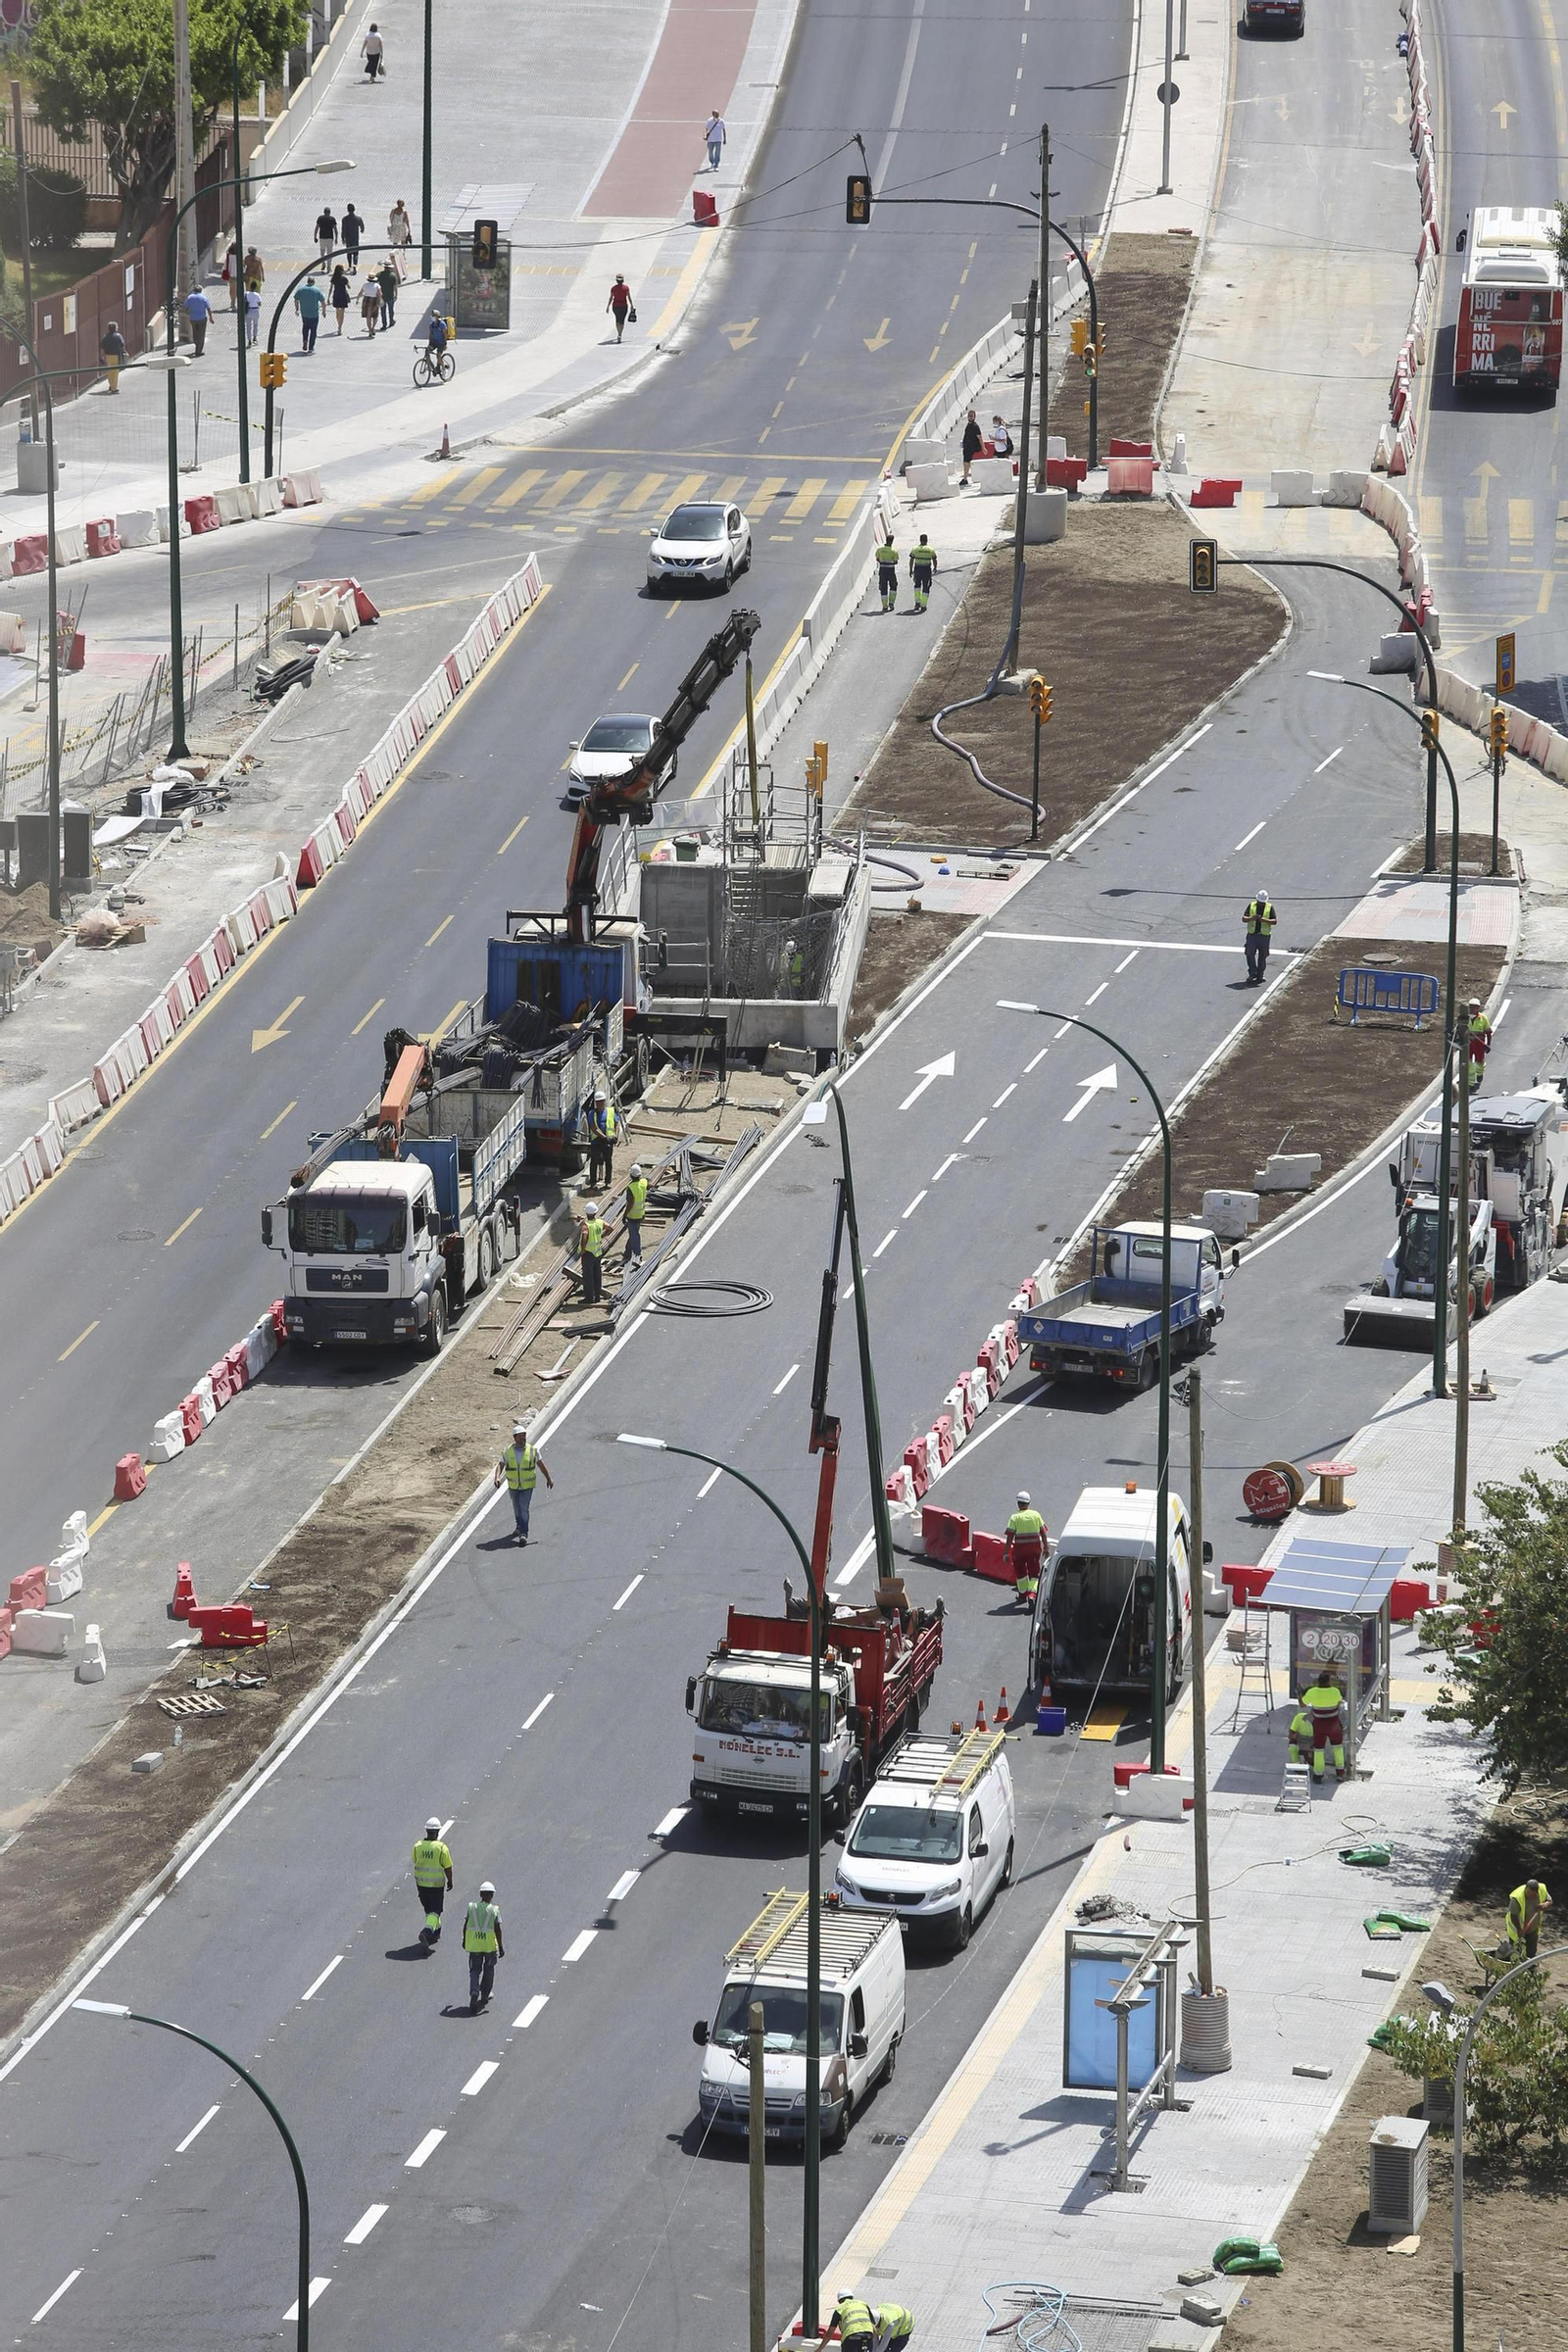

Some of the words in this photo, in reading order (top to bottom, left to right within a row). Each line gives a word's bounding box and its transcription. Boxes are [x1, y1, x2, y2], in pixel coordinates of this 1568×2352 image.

[1475, 292, 1502, 310] BUE
[1472, 333, 1495, 351] RRI
[1471, 353, 1498, 371] MA.
[1323, 1634, 1338, 1645] 20
[1344, 1636, 1358, 1646] 30
[719, 1740, 772, 1755] MONELEC
[776, 1748, 801, 1759] S.L.
